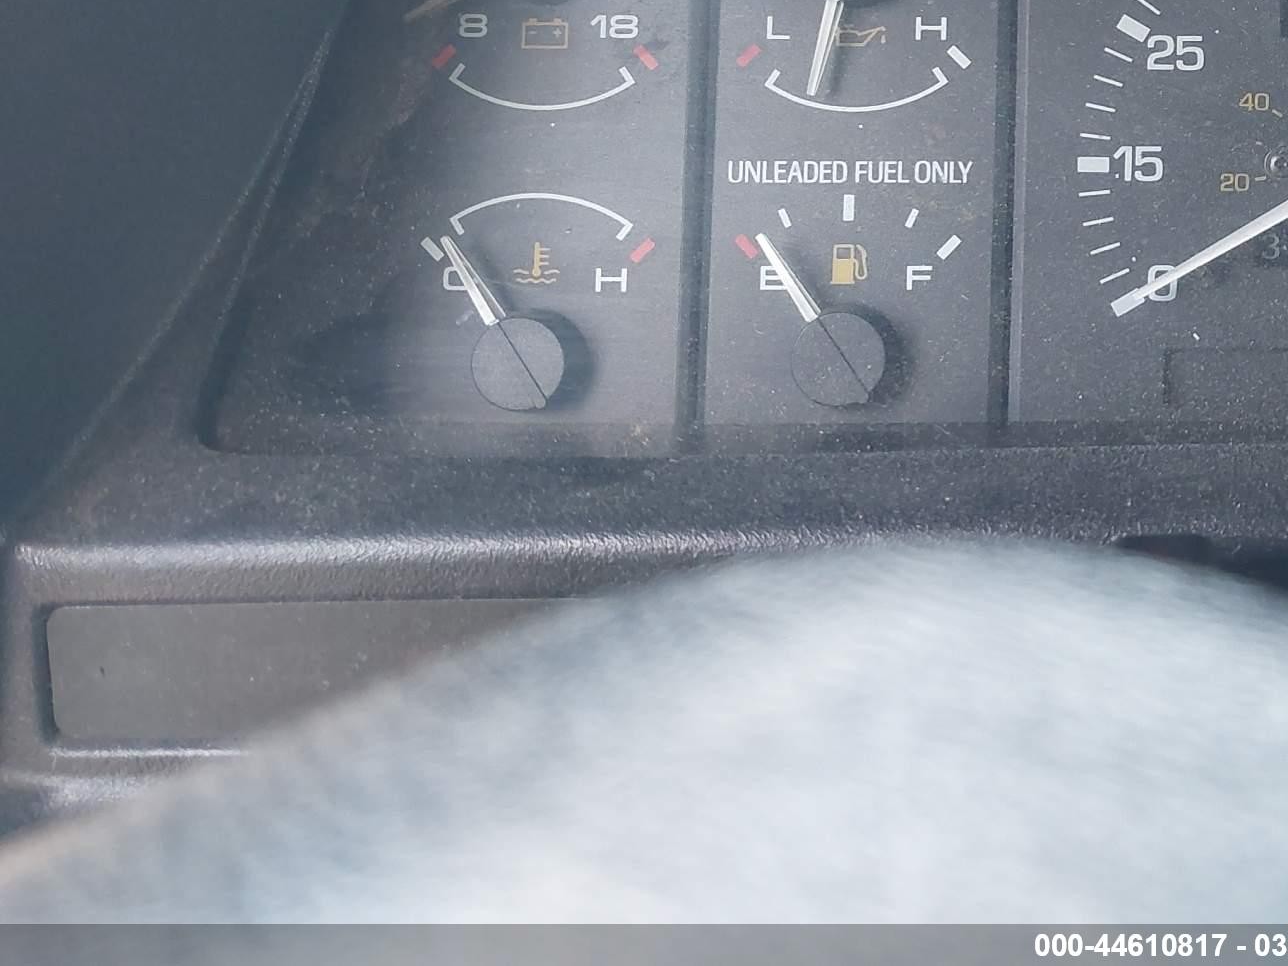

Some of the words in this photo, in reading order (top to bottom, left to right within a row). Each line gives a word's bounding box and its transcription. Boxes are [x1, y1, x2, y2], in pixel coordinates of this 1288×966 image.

[459, 14, 488, 37] 8
[590, 15, 639, 38] 18
[767, 16, 790, 40] L
[915, 17, 947, 40] H
[1146, 36, 1204, 71] 25
[1239, 92, 1270, 112] 40
[727, 161, 848, 184] UNLEADED
[854, 161, 909, 184] FUEL
[914, 161, 973, 184] ONLY
[1113, 146, 1164, 182] 15
[1219, 172, 1250, 192] 20
[595, 268, 628, 292] H
[906, 266, 933, 290] F
